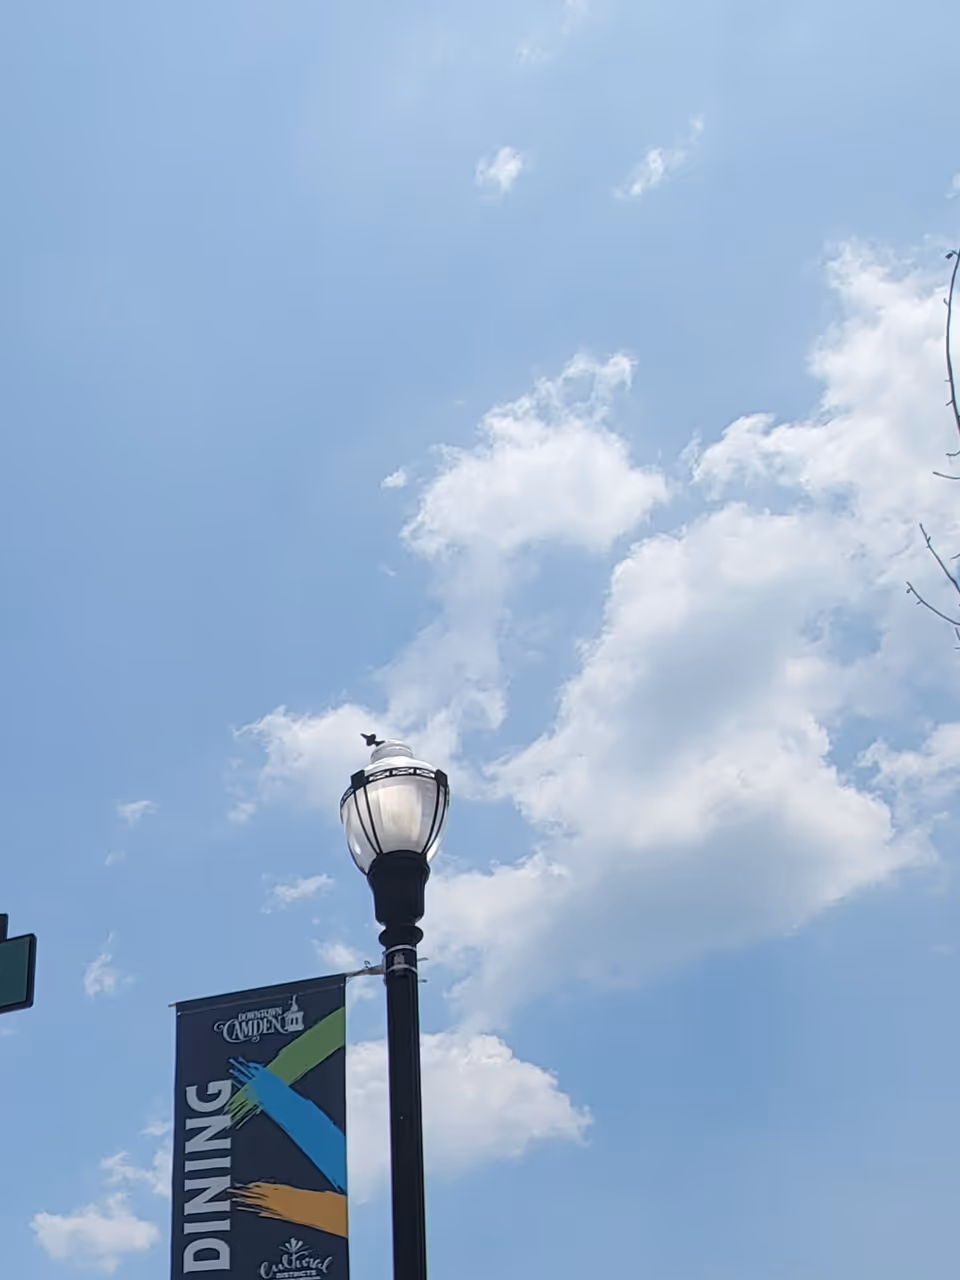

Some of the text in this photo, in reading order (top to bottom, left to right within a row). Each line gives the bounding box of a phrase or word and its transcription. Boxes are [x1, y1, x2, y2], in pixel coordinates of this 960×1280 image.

[238, 1006, 283, 1021] DOWNTOWN
[213, 1015, 289, 1043] CAMDEN
[183, 1079, 233, 1274] DINING
